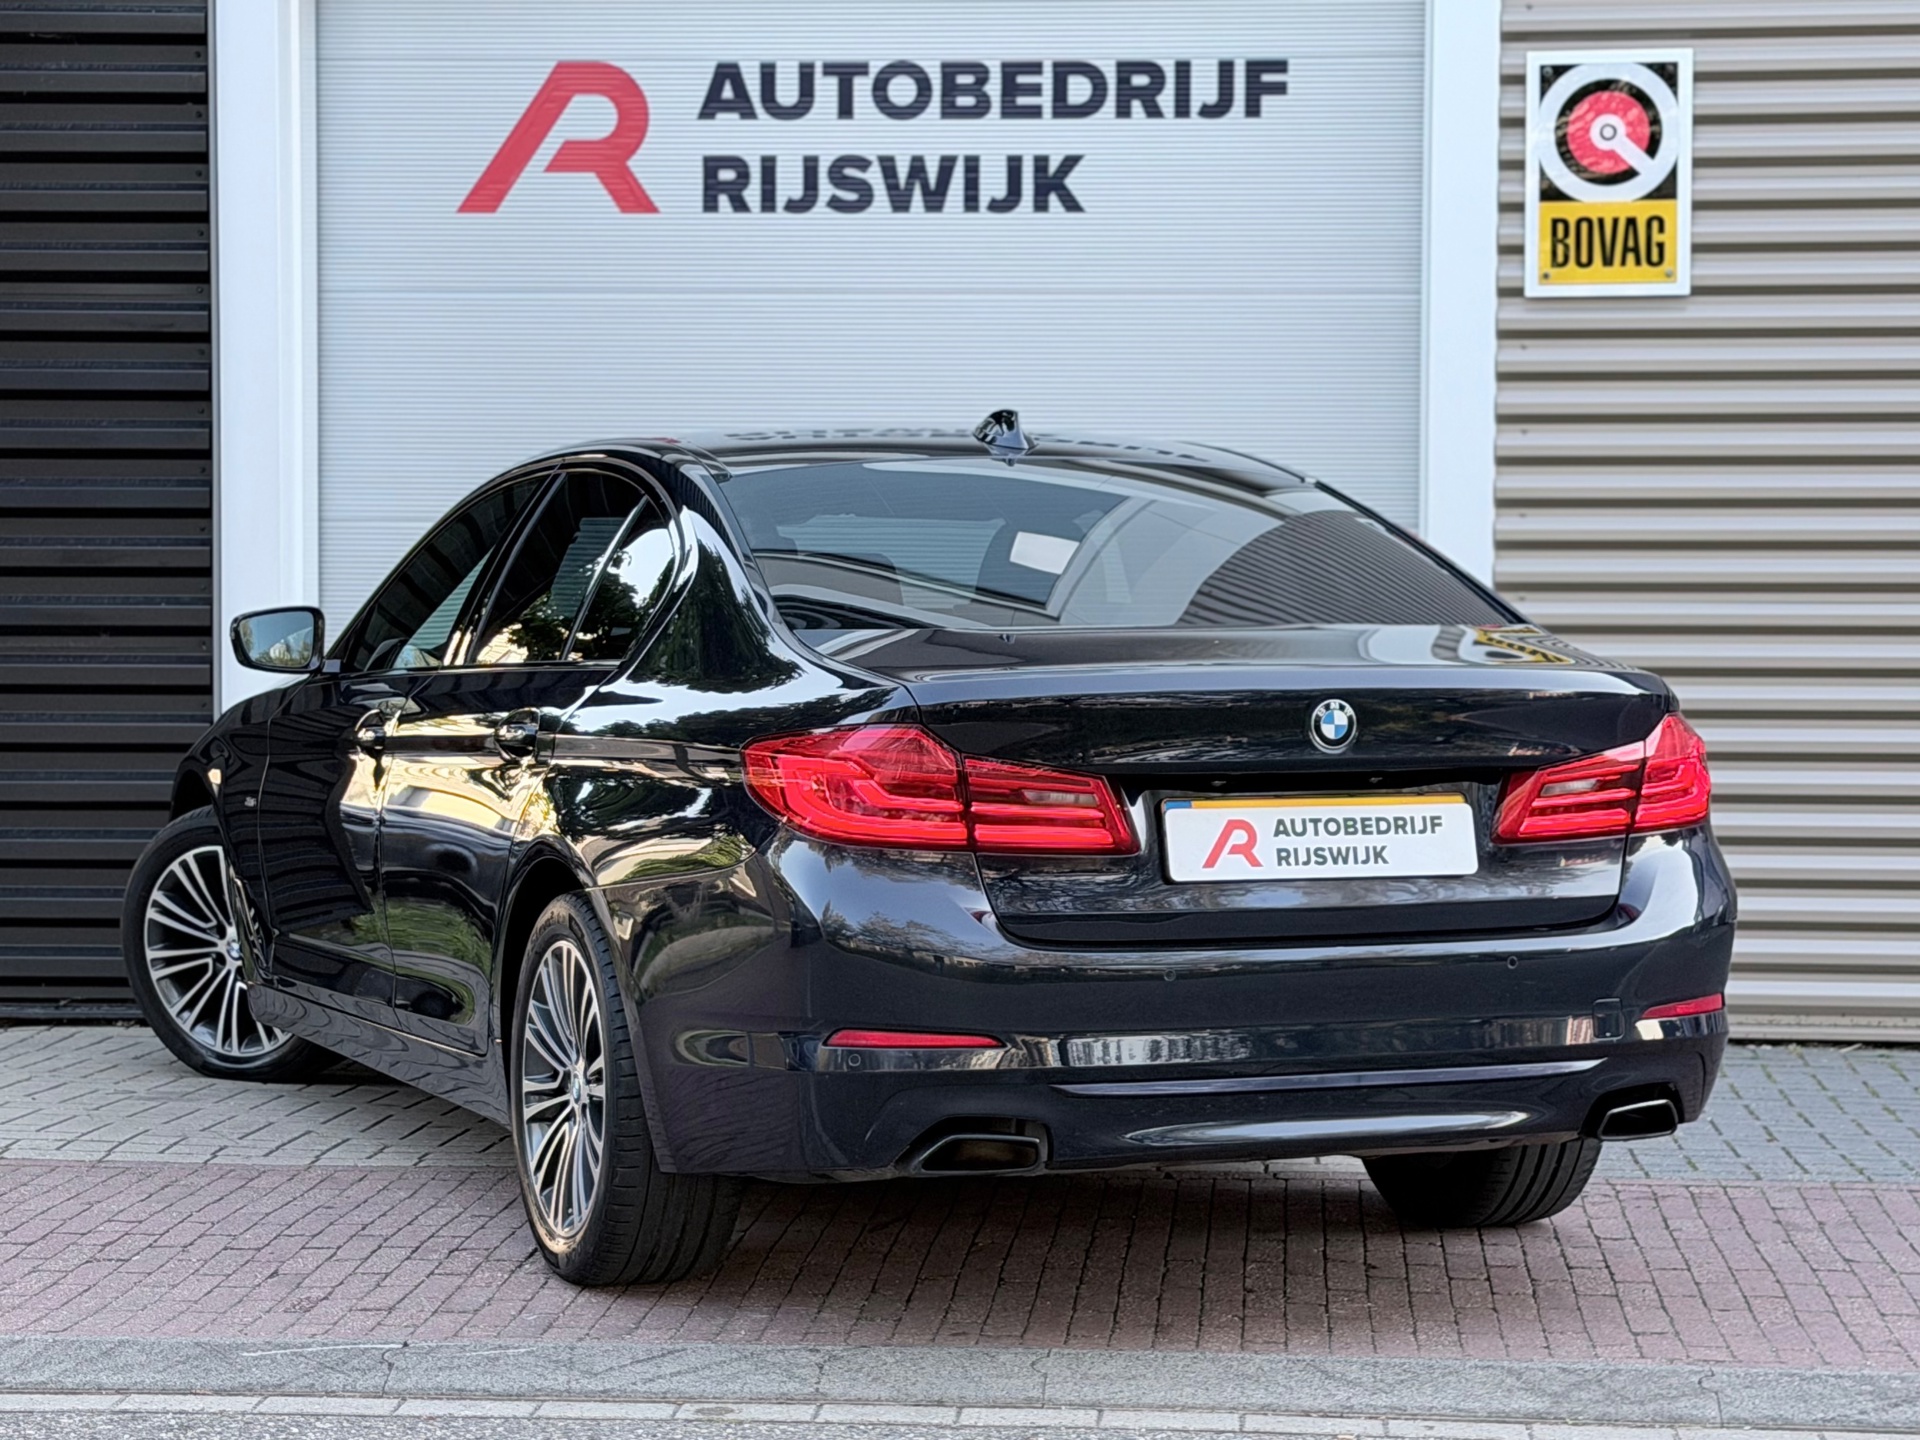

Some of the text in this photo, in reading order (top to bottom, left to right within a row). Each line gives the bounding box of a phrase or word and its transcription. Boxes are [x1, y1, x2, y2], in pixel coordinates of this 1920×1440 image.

[698, 59, 1289, 121] AUTOBEDRIJF
[702, 155, 1085, 213] RIJSWIJK
[1551, 214, 1665, 268] BOVAG
[1273, 815, 1443, 838] AUTOBEDRIJF
[1276, 845, 1389, 867] RIJSWIJK
